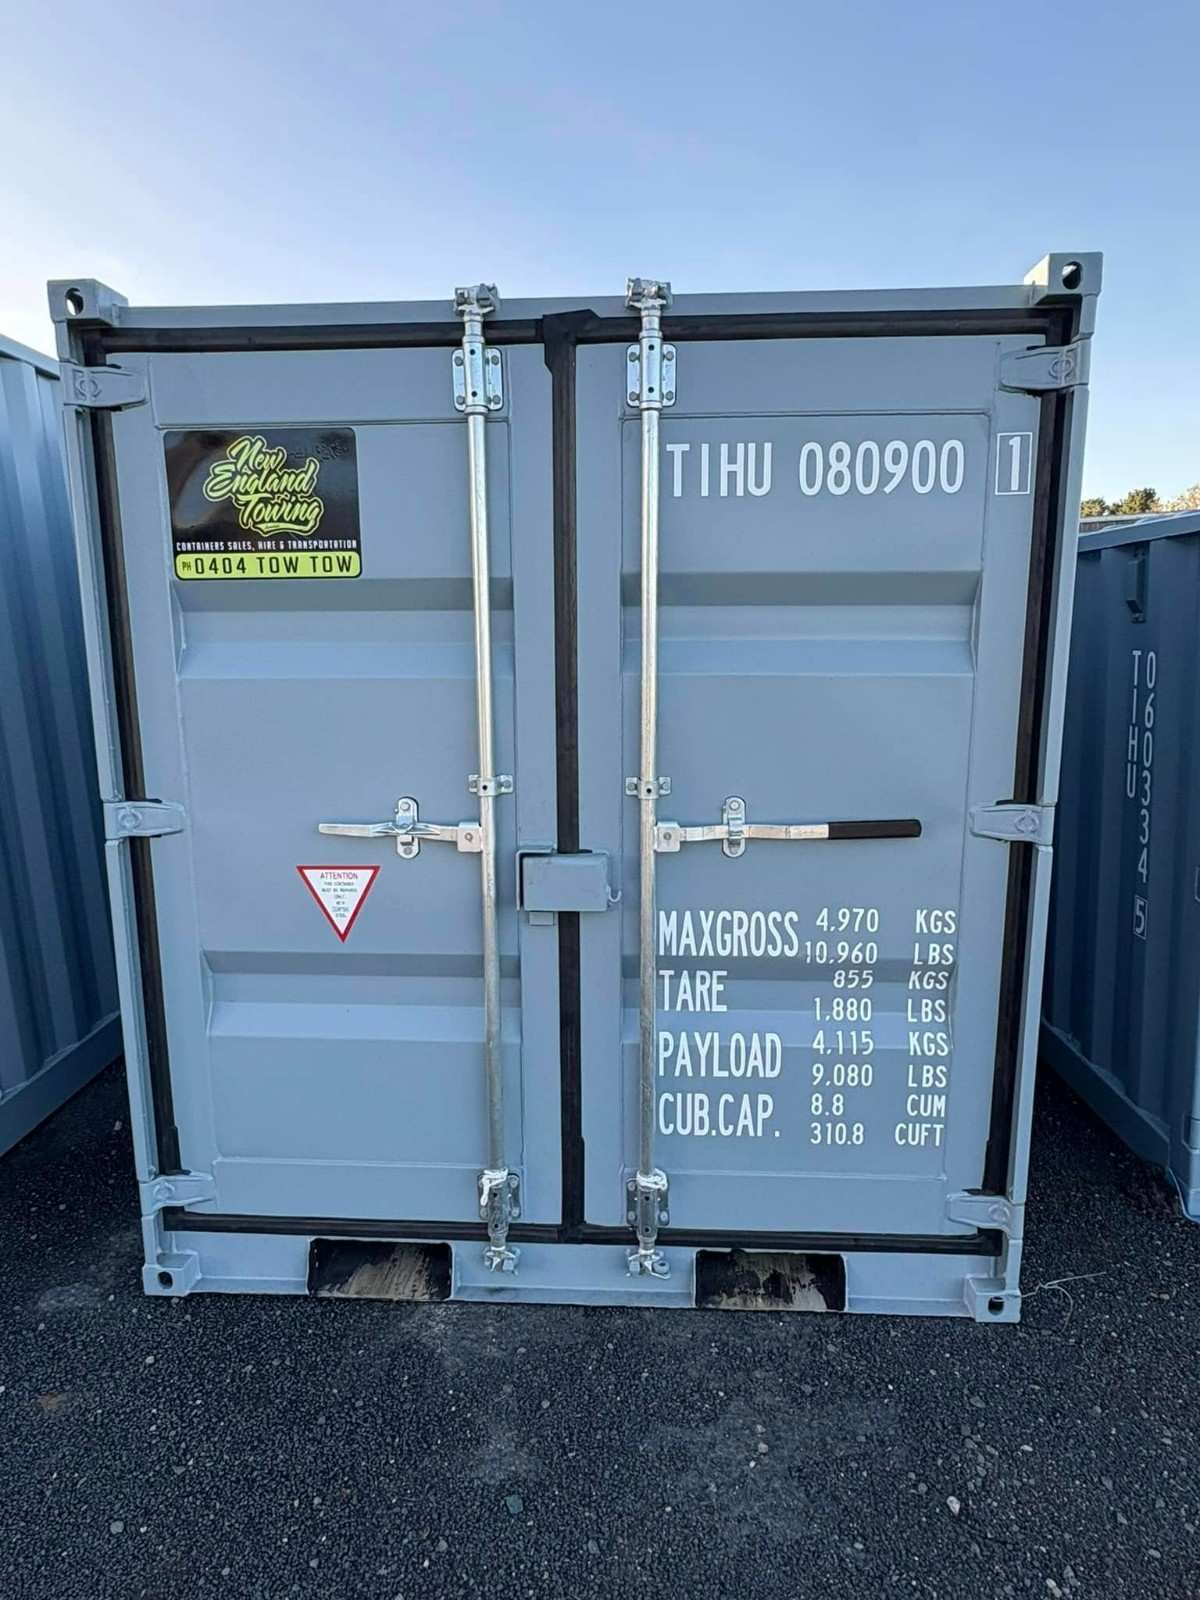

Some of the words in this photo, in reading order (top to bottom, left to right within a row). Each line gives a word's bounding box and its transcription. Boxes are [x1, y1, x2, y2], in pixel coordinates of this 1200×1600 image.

[229, 436, 285, 472] New
[665, 442, 773, 497] TIHU
[799, 439, 965, 496] 080900
[205, 458, 318, 499] England
[236, 493, 322, 529] Towing
[176, 542, 224, 551] CONTAINERS
[228, 542, 256, 551] SALES,
[258, 541, 276, 550] HIRE
[288, 540, 357, 549] TRANSPORTATION
[182, 561, 191, 571] PH
[195, 557, 247, 574] 0404
[256, 556, 299, 574] TOW
[309, 555, 353, 573] TOW
[1127, 650, 1142, 798] TIHU
[1137, 651, 1156, 883] 060334
[320, 872, 358, 880] ATTENTION
[658, 910, 799, 957] MAXGROSS
[915, 909, 957, 934] KGS
[1134, 900, 1146, 934] 5
[913, 942, 955, 966] LBS
[658, 970, 728, 1012] TARE
[833, 970, 874, 989] 855
[908, 970, 950, 990] KGS
[906, 998, 946, 1023] LBS
[658, 1031, 782, 1078] PAYLOAD
[908, 1031, 950, 1056] KGS
[907, 1064, 948, 1088] LBS
[658, 1092, 781, 1137] CUB.CAP.
[810, 1093, 844, 1116] 8.8
[906, 1094, 946, 1117] CUM
[810, 1123, 865, 1145] 310.8
[895, 1123, 945, 1146] CUFT
